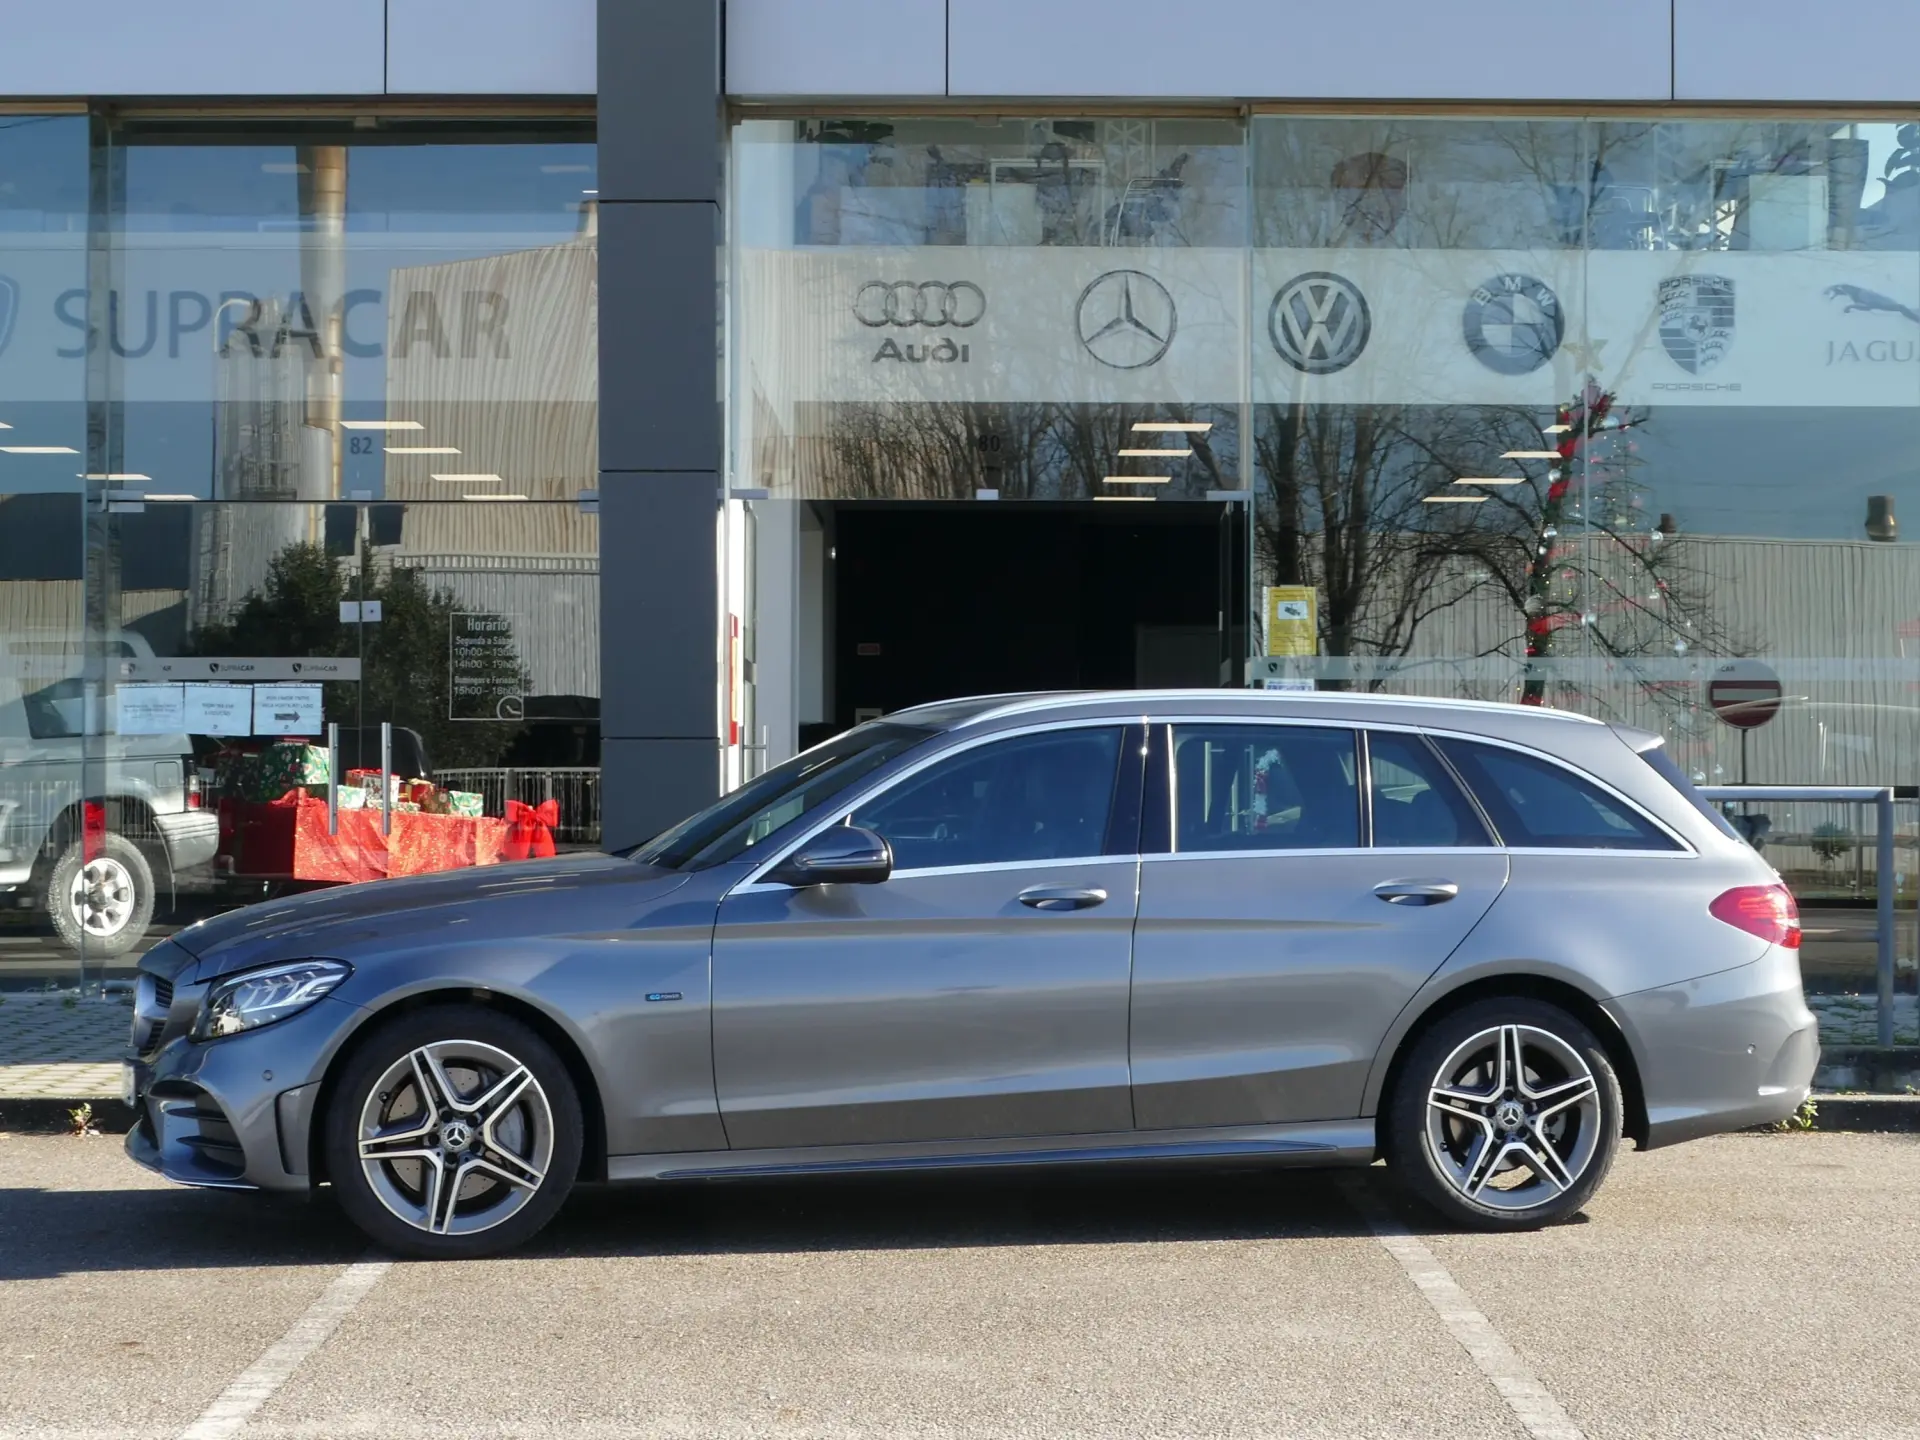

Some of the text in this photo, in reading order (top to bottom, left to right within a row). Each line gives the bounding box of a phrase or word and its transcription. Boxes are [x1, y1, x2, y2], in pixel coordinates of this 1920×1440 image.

[1473, 276, 1554, 307] BMW
[53, 289, 512, 360] SUPRACAR
[871, 337, 970, 364] Audi
[1825, 340, 1920, 368] JAGU
[1651, 383, 1742, 391] PORSCHE
[349, 437, 373, 455] 82
[979, 434, 1000, 451] 80
[467, 617, 508, 631] Horário
[454, 648, 483, 656] 10h00
[455, 660, 482, 669] 14h00
[454, 686, 482, 695] 15h00
